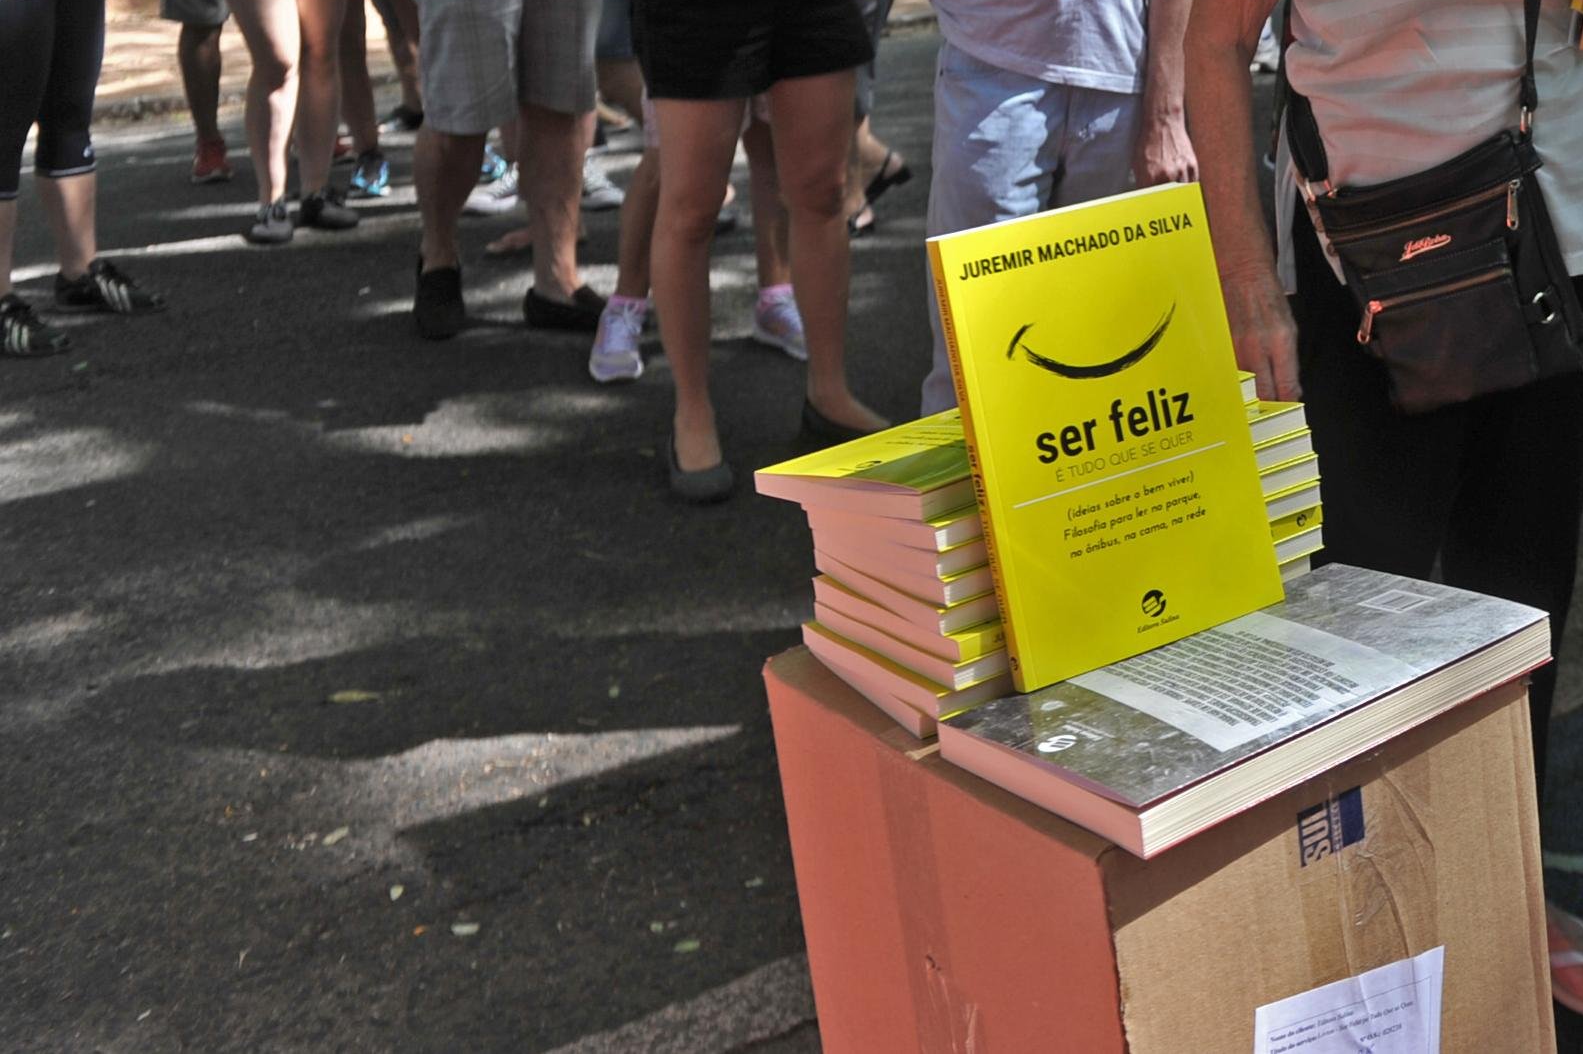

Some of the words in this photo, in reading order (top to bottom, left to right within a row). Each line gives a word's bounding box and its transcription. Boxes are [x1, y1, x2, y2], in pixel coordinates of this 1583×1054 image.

[959, 248, 1034, 281] JUREMIR
[1037, 230, 1120, 263] MACHADO
[1124, 224, 1146, 243] DA
[1149, 213, 1193, 237] SILVA
[1035, 418, 1097, 465] ser
[1109, 388, 1194, 443] feliz
[1056, 468, 1064, 483] É
[1067, 457, 1106, 477] TUDO
[1109, 449, 1138, 467] QUE
[1141, 442, 1157, 457] SE
[1160, 431, 1193, 450] QUER
[1063, 518, 1108, 541] Filosofia
[1110, 513, 1133, 532] para
[1135, 506, 1148, 520] ler
[1151, 505, 1163, 516] no
[1166, 492, 1201, 514] parque,
[1067, 504, 1101, 522] (ideias
[1104, 492, 1132, 510] sobre
[1133, 492, 1141, 500] o
[1143, 482, 1165, 497] bem
[1168, 470, 1195, 489] viver)
[1070, 548, 1083, 560] no
[1123, 530, 1137, 542] na
[1171, 516, 1185, 528] na
[1186, 506, 1207, 522] rede
